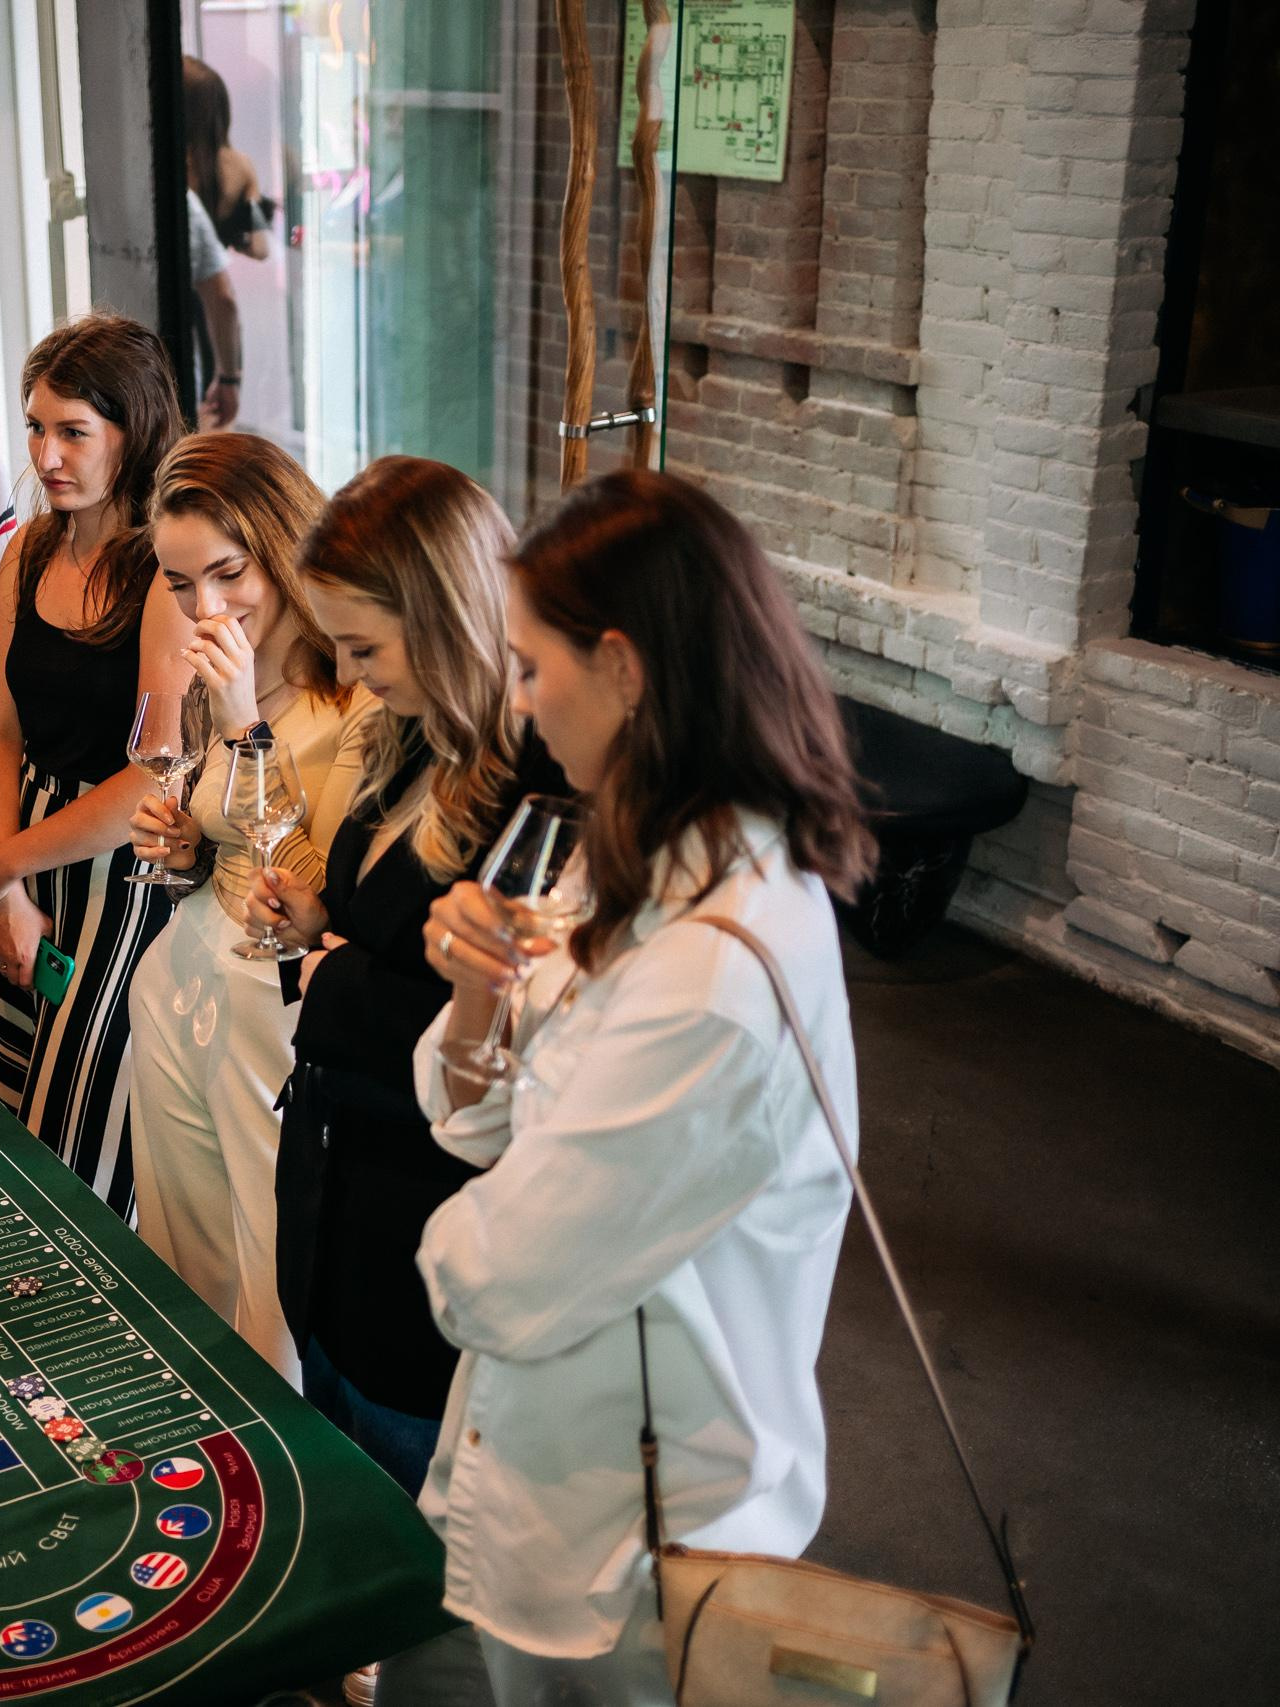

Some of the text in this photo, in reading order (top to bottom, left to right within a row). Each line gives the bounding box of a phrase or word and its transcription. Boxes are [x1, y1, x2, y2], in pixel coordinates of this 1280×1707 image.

[53, 1227, 119, 1290] белые сорта
[10, 1288, 77, 1312] Гарганега
[33, 1307, 87, 1328] Кортезе
[45, 1340, 141, 1373] Пино Гриджио
[84, 1364, 134, 1385] Мускат
[79, 1398, 113, 1412] Блан
[117, 1406, 172, 1427] Рислинг
[133, 1423, 203, 1449] Шардоне
[227, 1498, 240, 1528] Новая
[38, 1512, 80, 1550] СВЕТ
[196, 1577, 225, 1603] США
[107, 1619, 179, 1663] Аргентина
